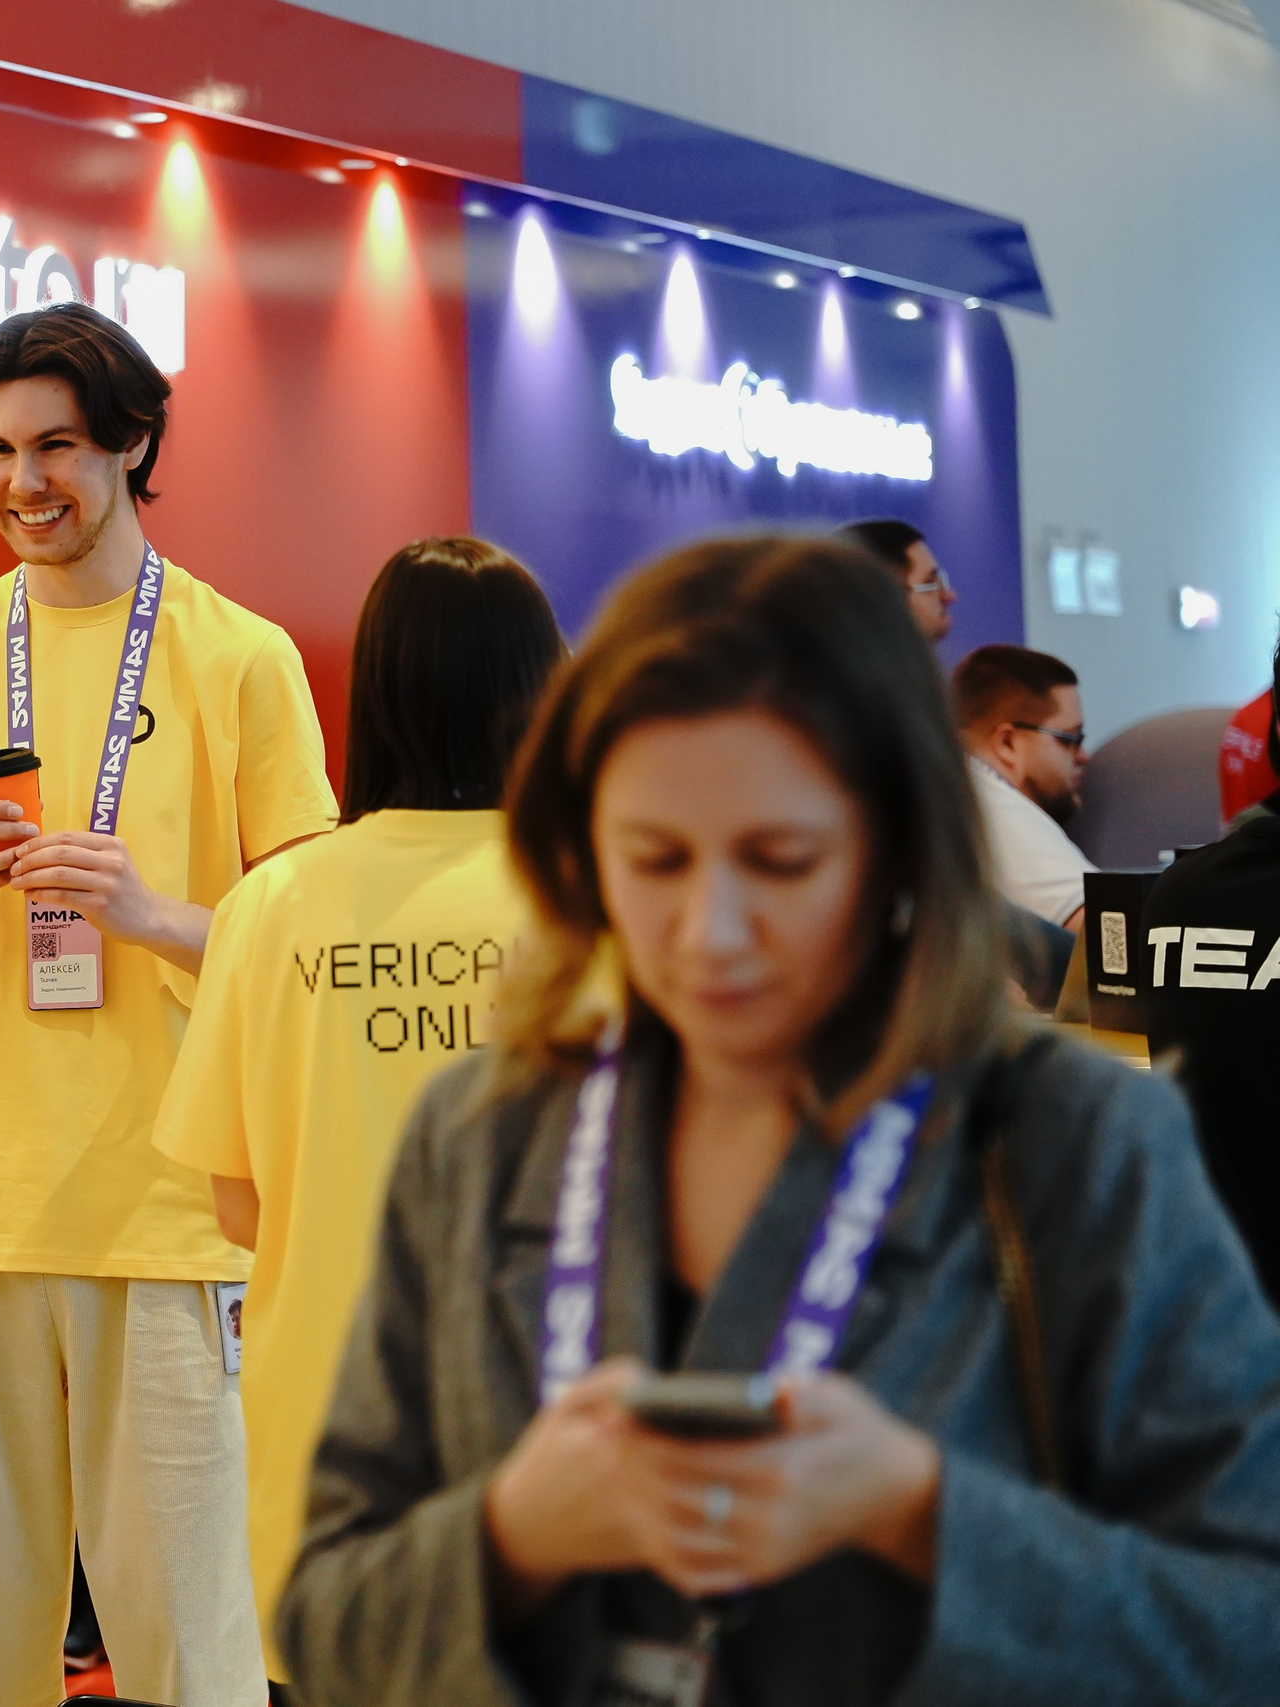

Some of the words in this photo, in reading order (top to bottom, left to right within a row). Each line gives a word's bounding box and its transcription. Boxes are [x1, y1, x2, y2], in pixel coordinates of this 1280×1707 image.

[31, 923, 72, 931] СТЕНДИСТ
[39, 962, 81, 975] АЛЕКСЕЙ
[295, 937, 519, 994] VERICA
[366, 1003, 497, 1053] ONL
